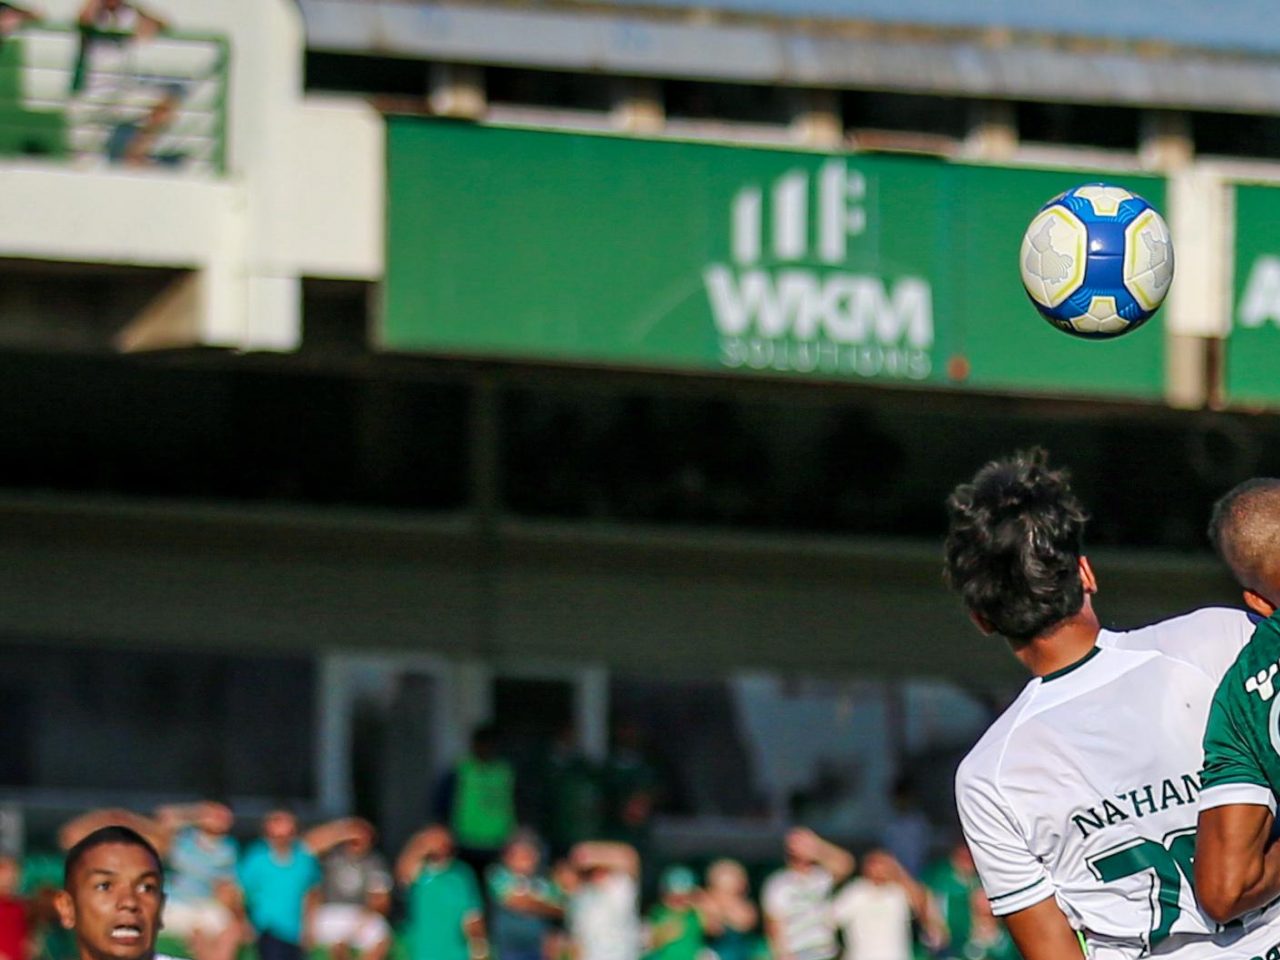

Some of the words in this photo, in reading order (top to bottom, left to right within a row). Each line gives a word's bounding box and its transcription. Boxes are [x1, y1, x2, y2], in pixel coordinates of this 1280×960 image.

[703, 265, 935, 350] WKM
[718, 338, 933, 382] SOLUTIONS
[1071, 770, 1204, 841] NAHAN
[1084, 825, 1200, 960] 7
